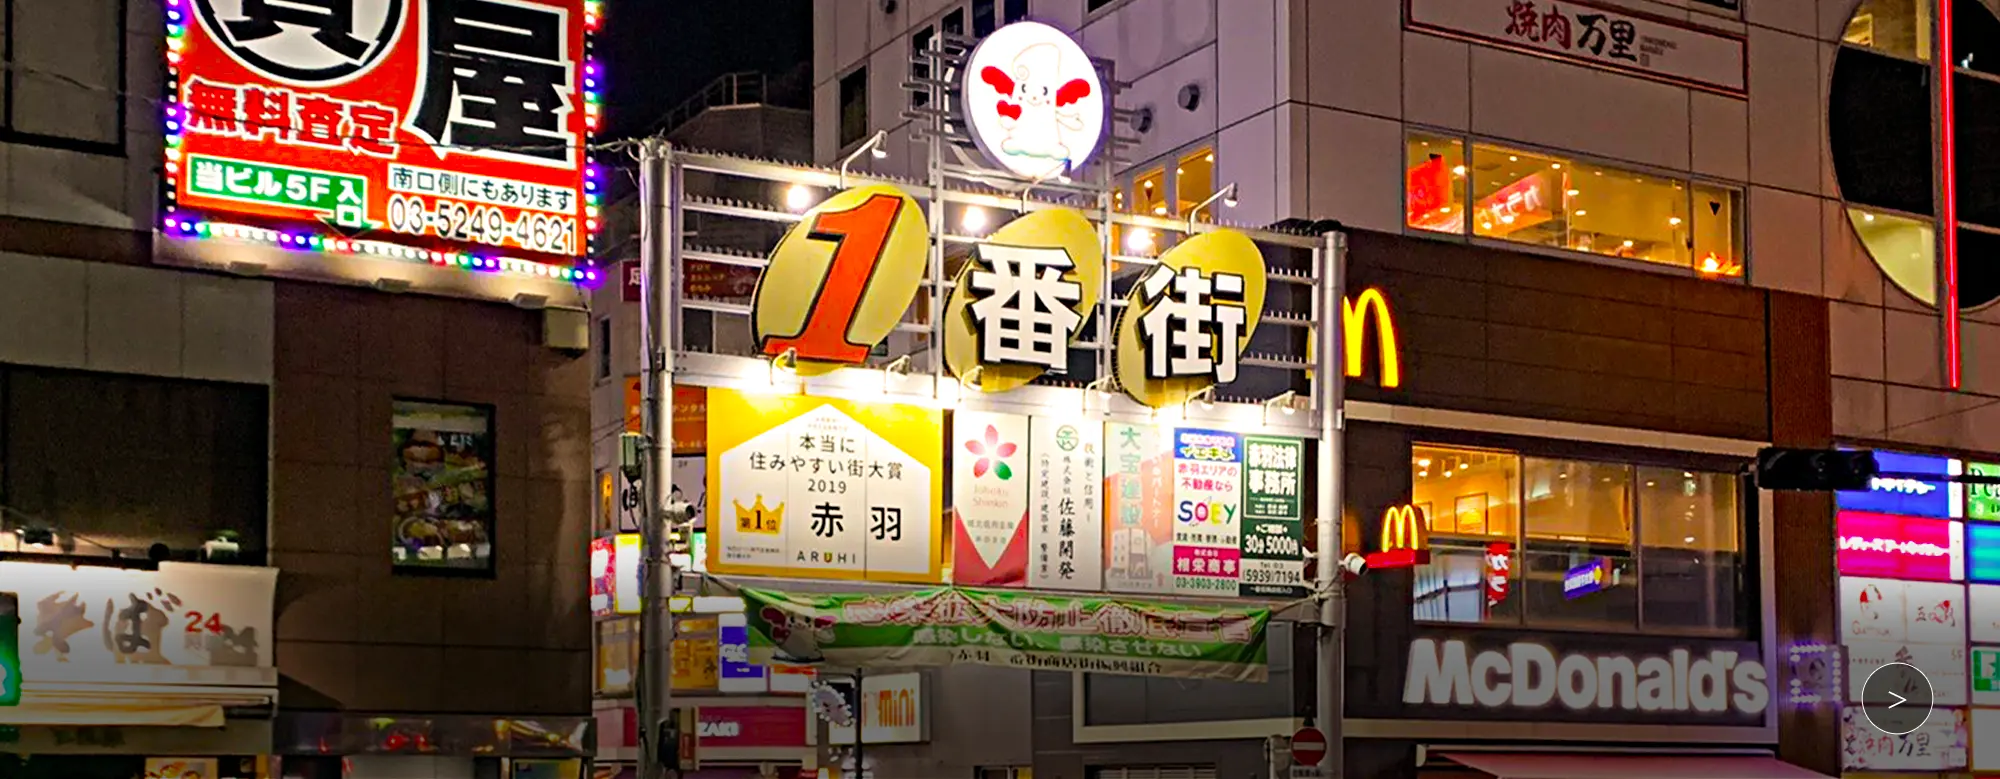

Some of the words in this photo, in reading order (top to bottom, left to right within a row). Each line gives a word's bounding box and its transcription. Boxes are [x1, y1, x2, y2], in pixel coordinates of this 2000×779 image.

[1505, 1, 1637, 62] 焼肉万里
[180, 76, 399, 158] 無料査定
[392, 167, 573, 210] 南口側にもあります
[391, 197, 576, 254] 03-5249-4621
[800, 433, 855, 454] 本当に
[750, 452, 902, 479] 住みやすい街大賞
[1178, 463, 1238, 477] 赤羽エリアの
[807, 478, 847, 494] 2019
[1181, 477, 1233, 492] 不動産なら
[811, 502, 902, 541] 赤羽
[1177, 500, 1237, 525] SOEY
[796, 550, 856, 564] ARUHI
[184, 611, 223, 634] 24
[1402, 638, 1769, 714] McDonald's
